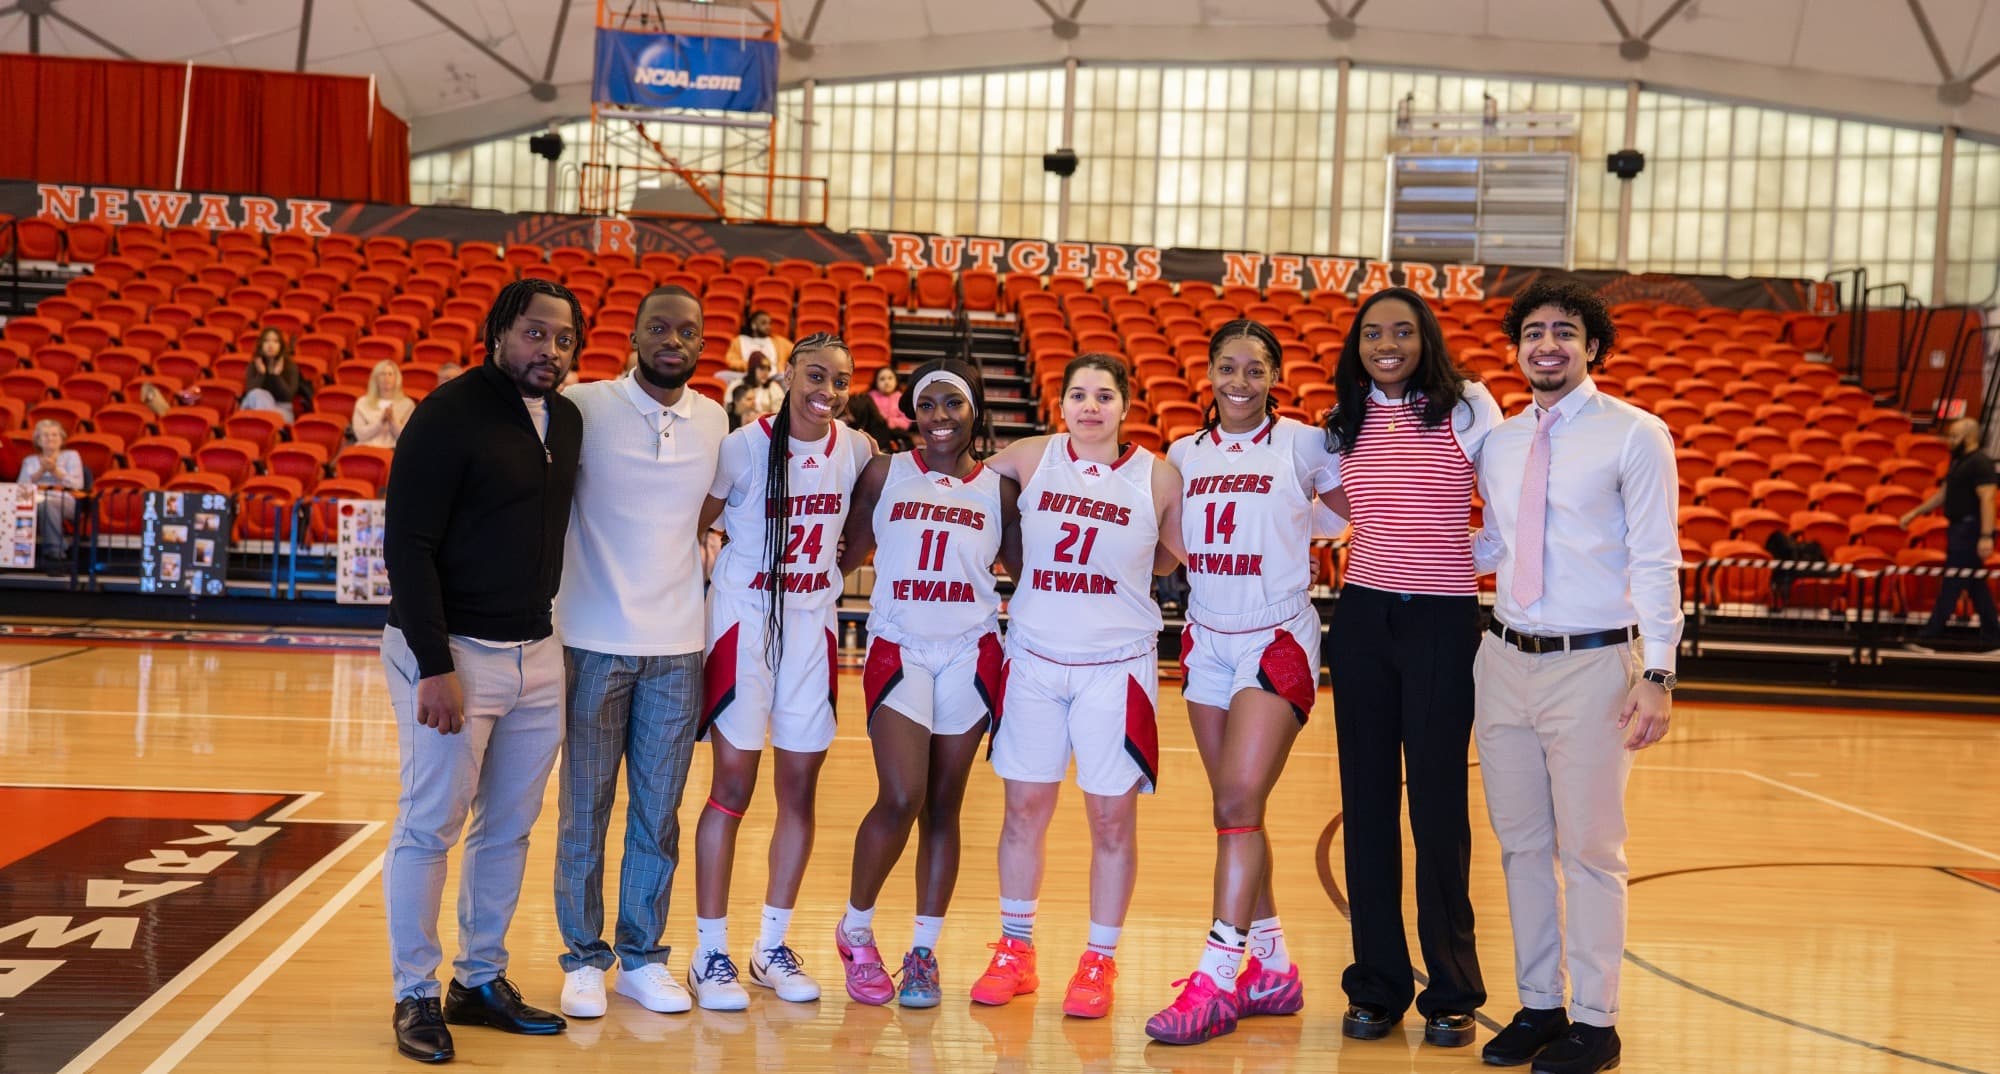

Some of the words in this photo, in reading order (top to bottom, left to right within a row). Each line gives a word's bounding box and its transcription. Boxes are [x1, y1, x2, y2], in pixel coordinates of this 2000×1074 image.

[634, 67, 742, 91] NCAA.com
[37, 184, 331, 236] NEWARK
[887, 233, 1162, 281] RUTGERS
[1222, 252, 1485, 299] NEWARK
[202, 494, 226, 510] SR
[889, 502, 985, 530] RUTGERS
[1038, 491, 1131, 526] RUTGERS
[1204, 501, 1236, 544] 14
[782, 524, 823, 564] 24
[918, 529, 950, 571] 11
[1054, 522, 1099, 565] 21
[1188, 552, 1263, 576] NEWARK
[0, 824, 281, 1017] WARK
